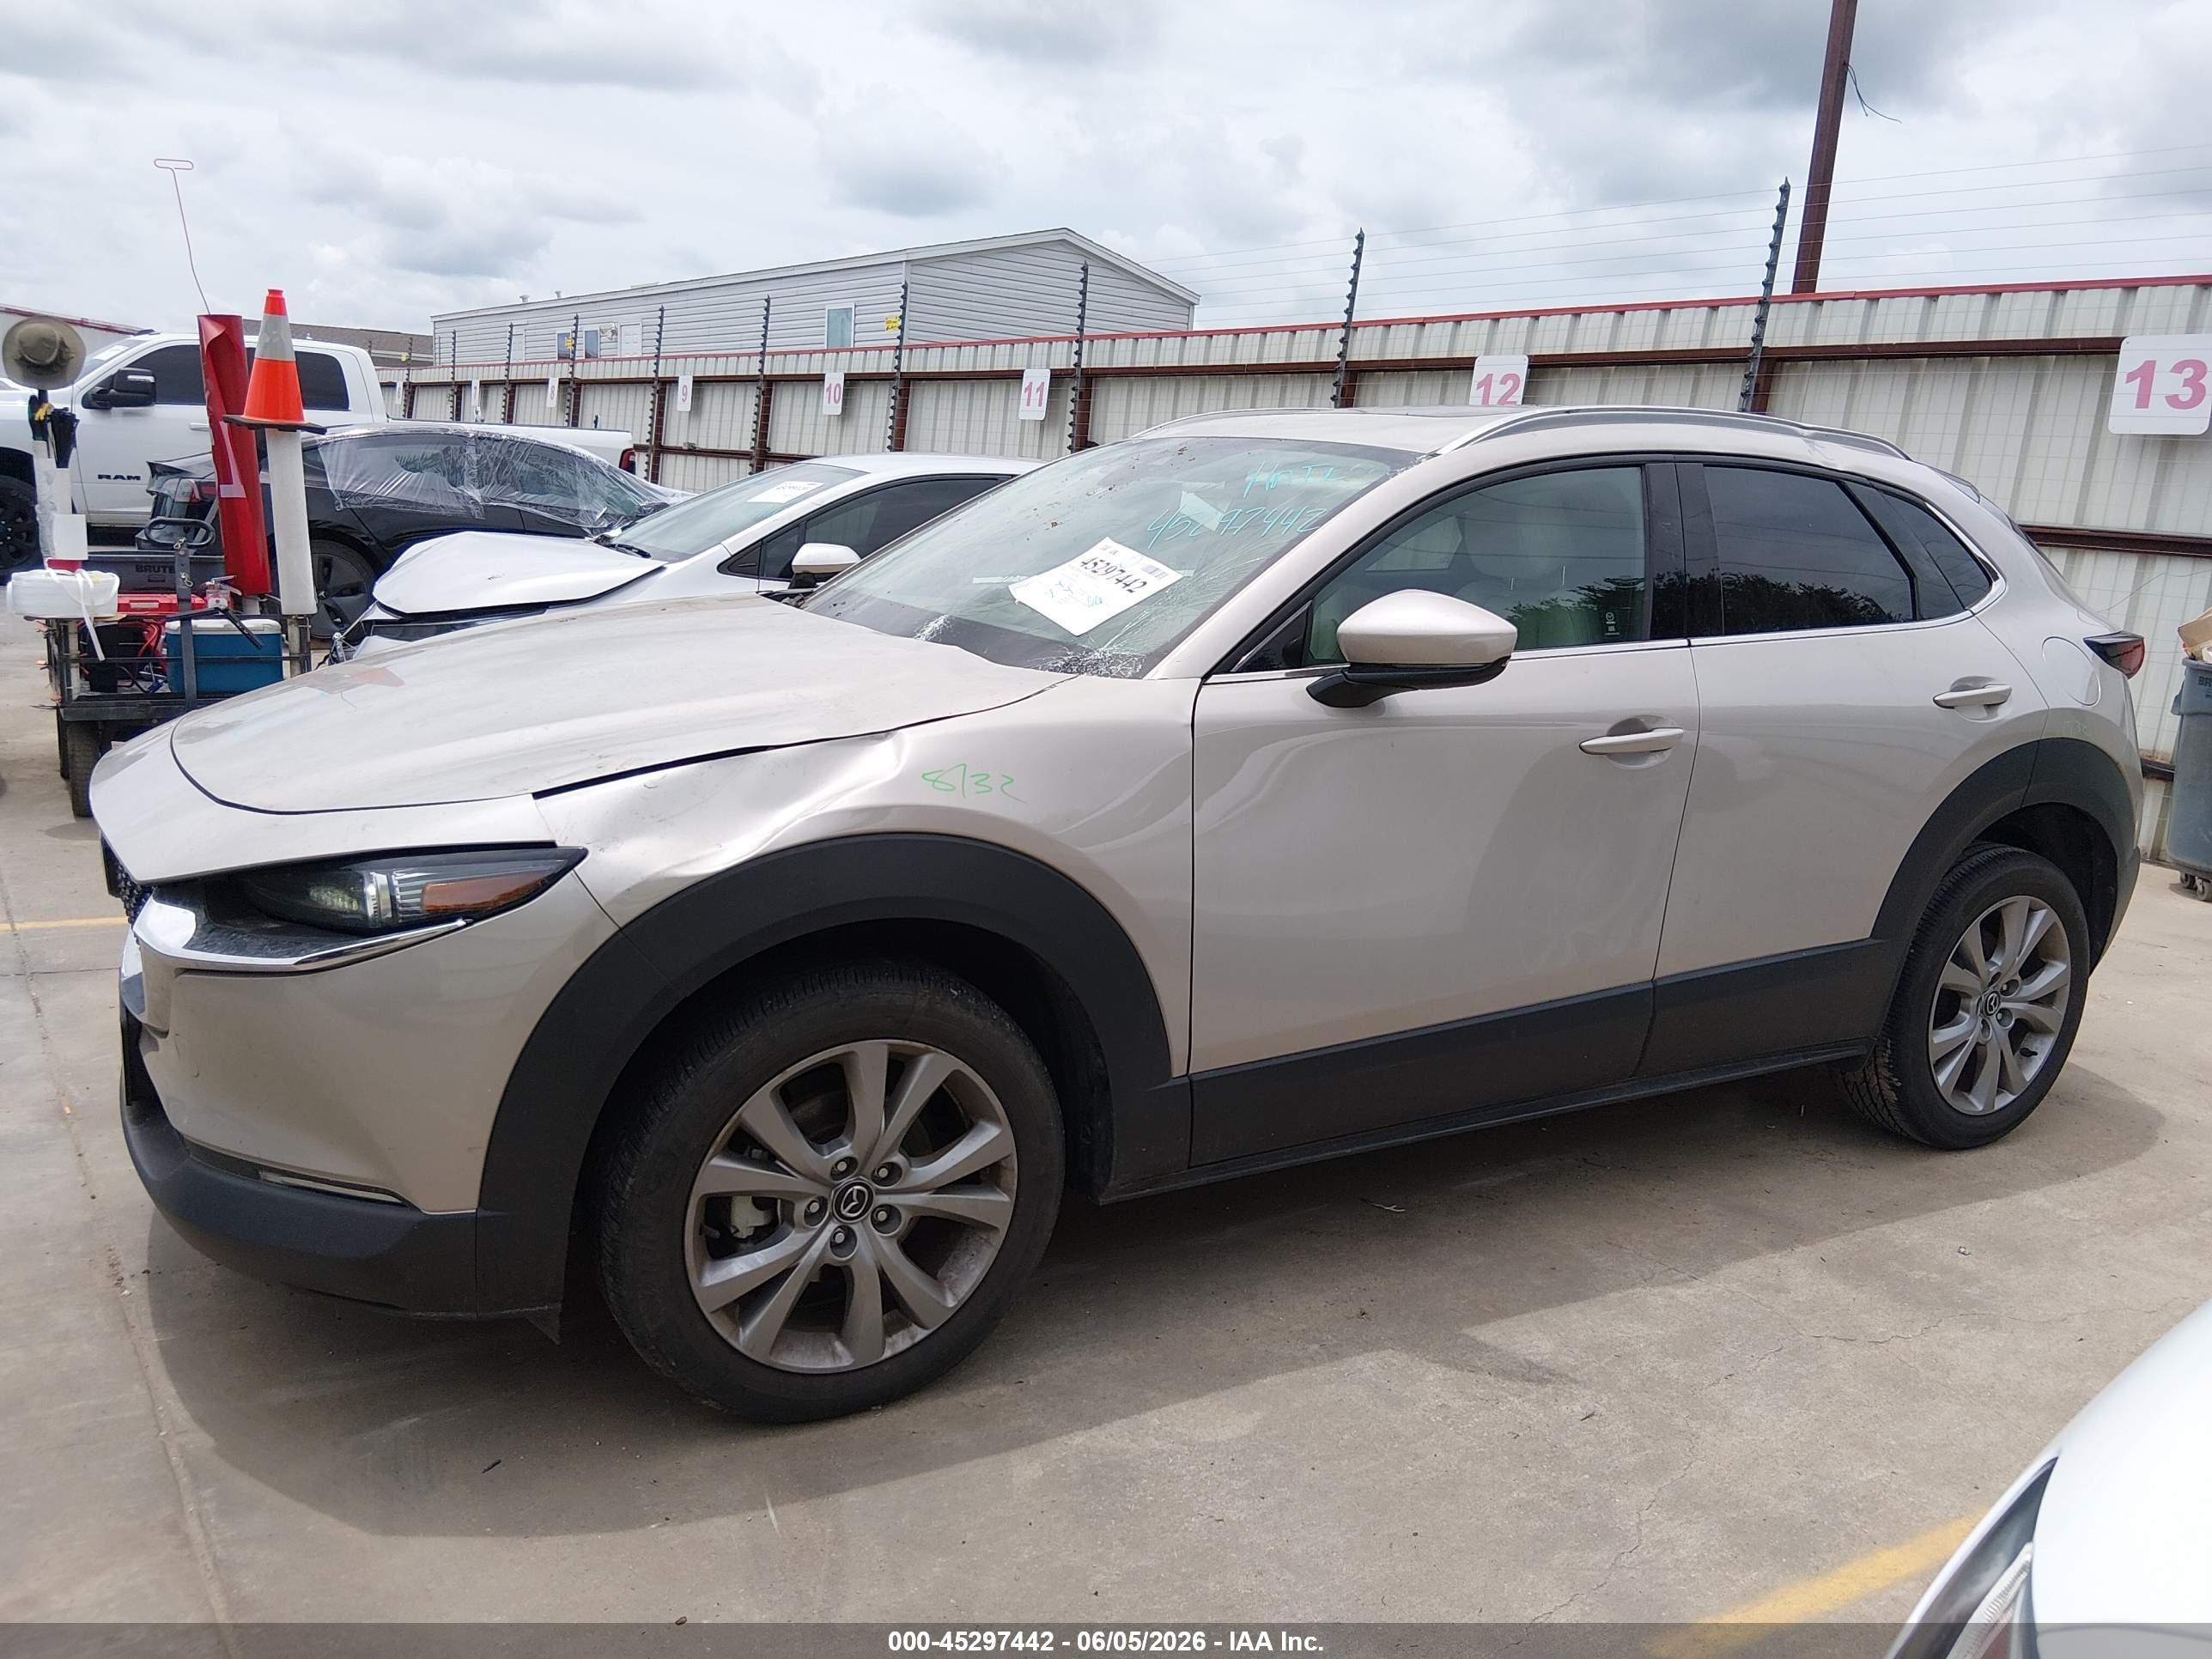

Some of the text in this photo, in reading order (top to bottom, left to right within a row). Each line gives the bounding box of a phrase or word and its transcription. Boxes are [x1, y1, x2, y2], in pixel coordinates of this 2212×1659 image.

[550, 386, 555, 400] 8
[682, 385, 688, 403] 9
[826, 383, 842, 404] 10
[1024, 381, 1044, 407] 11
[1476, 373, 1521, 406] 12
[2125, 359, 2208, 410] 13
[1080, 556, 1148, 593] 45297442
